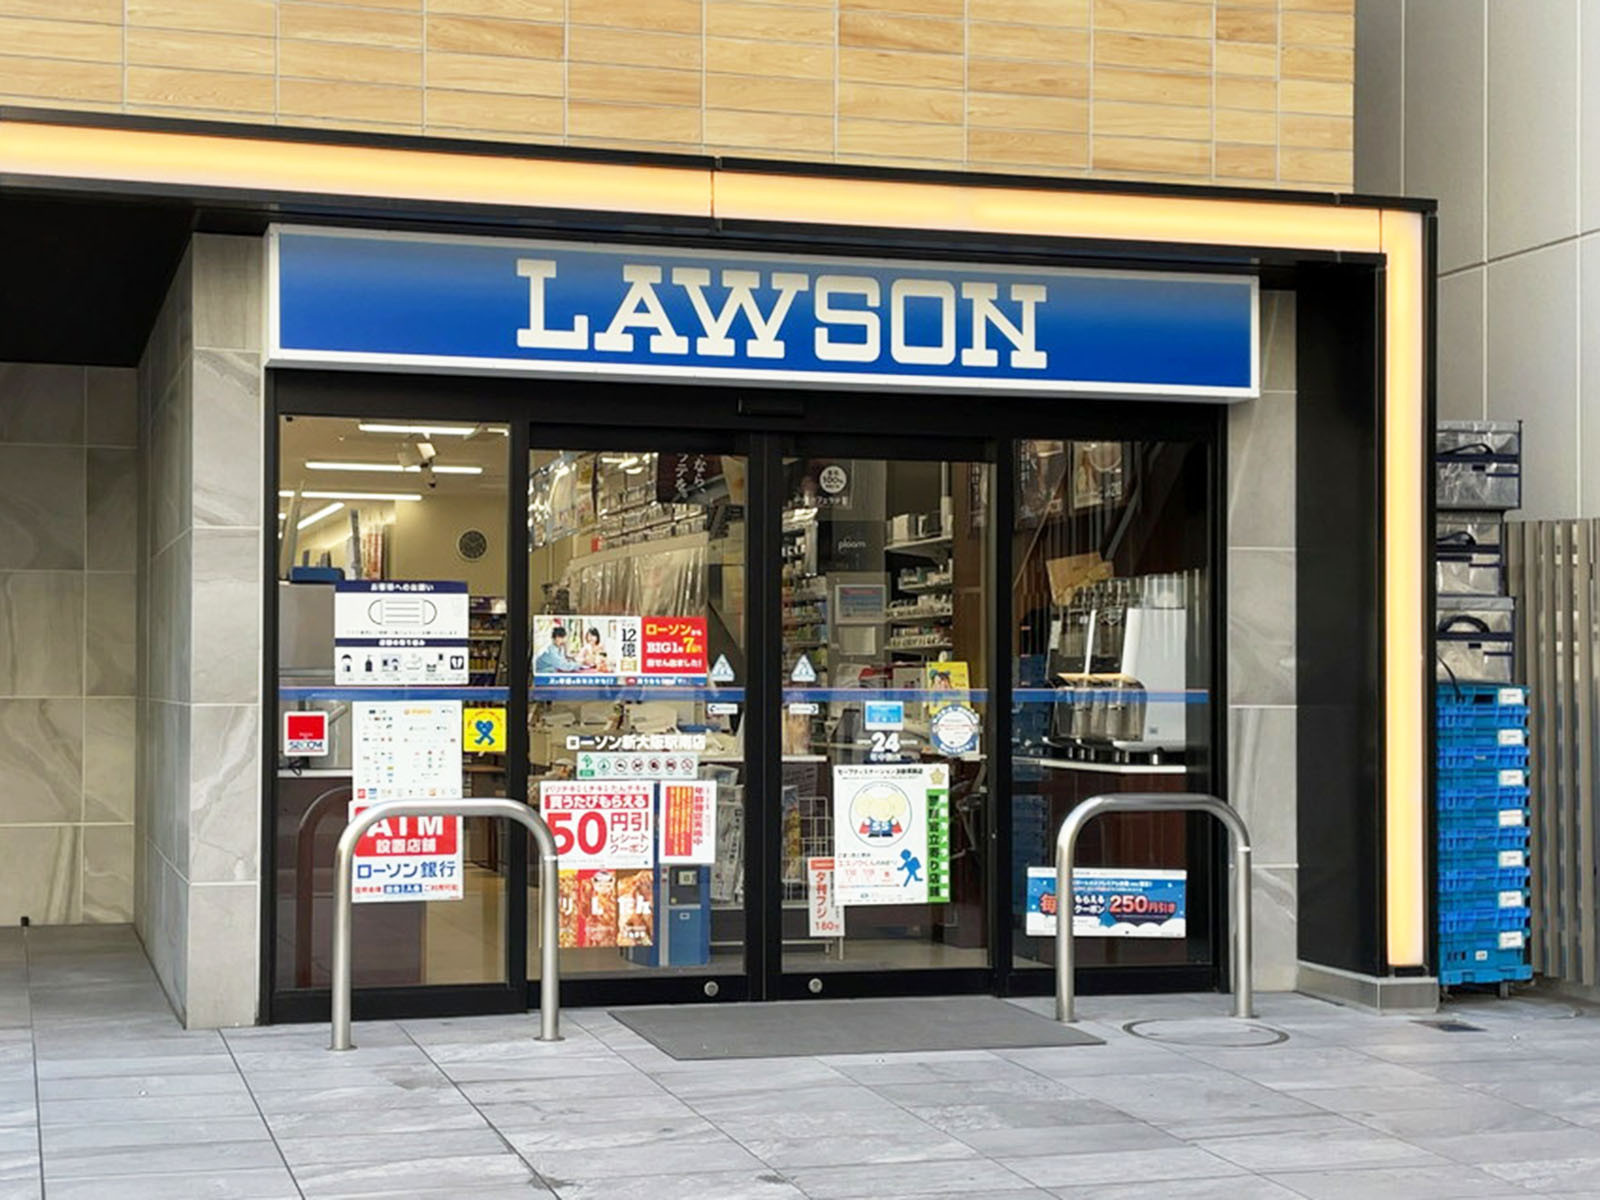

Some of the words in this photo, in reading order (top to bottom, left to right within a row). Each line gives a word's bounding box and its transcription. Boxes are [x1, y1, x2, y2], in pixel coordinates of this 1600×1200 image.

[515, 258, 1049, 370] LAWSON
[838, 537, 867, 552] ploom
[290, 739, 324, 750] SECOM
[870, 731, 900, 752] 24
[550, 794, 648, 809] 買うたびもらえる
[375, 838, 437, 854] 設置店舗
[610, 833, 649, 844] レシート
[610, 844, 649, 854] クーポン
[357, 861, 456, 879] ローソン銀行
